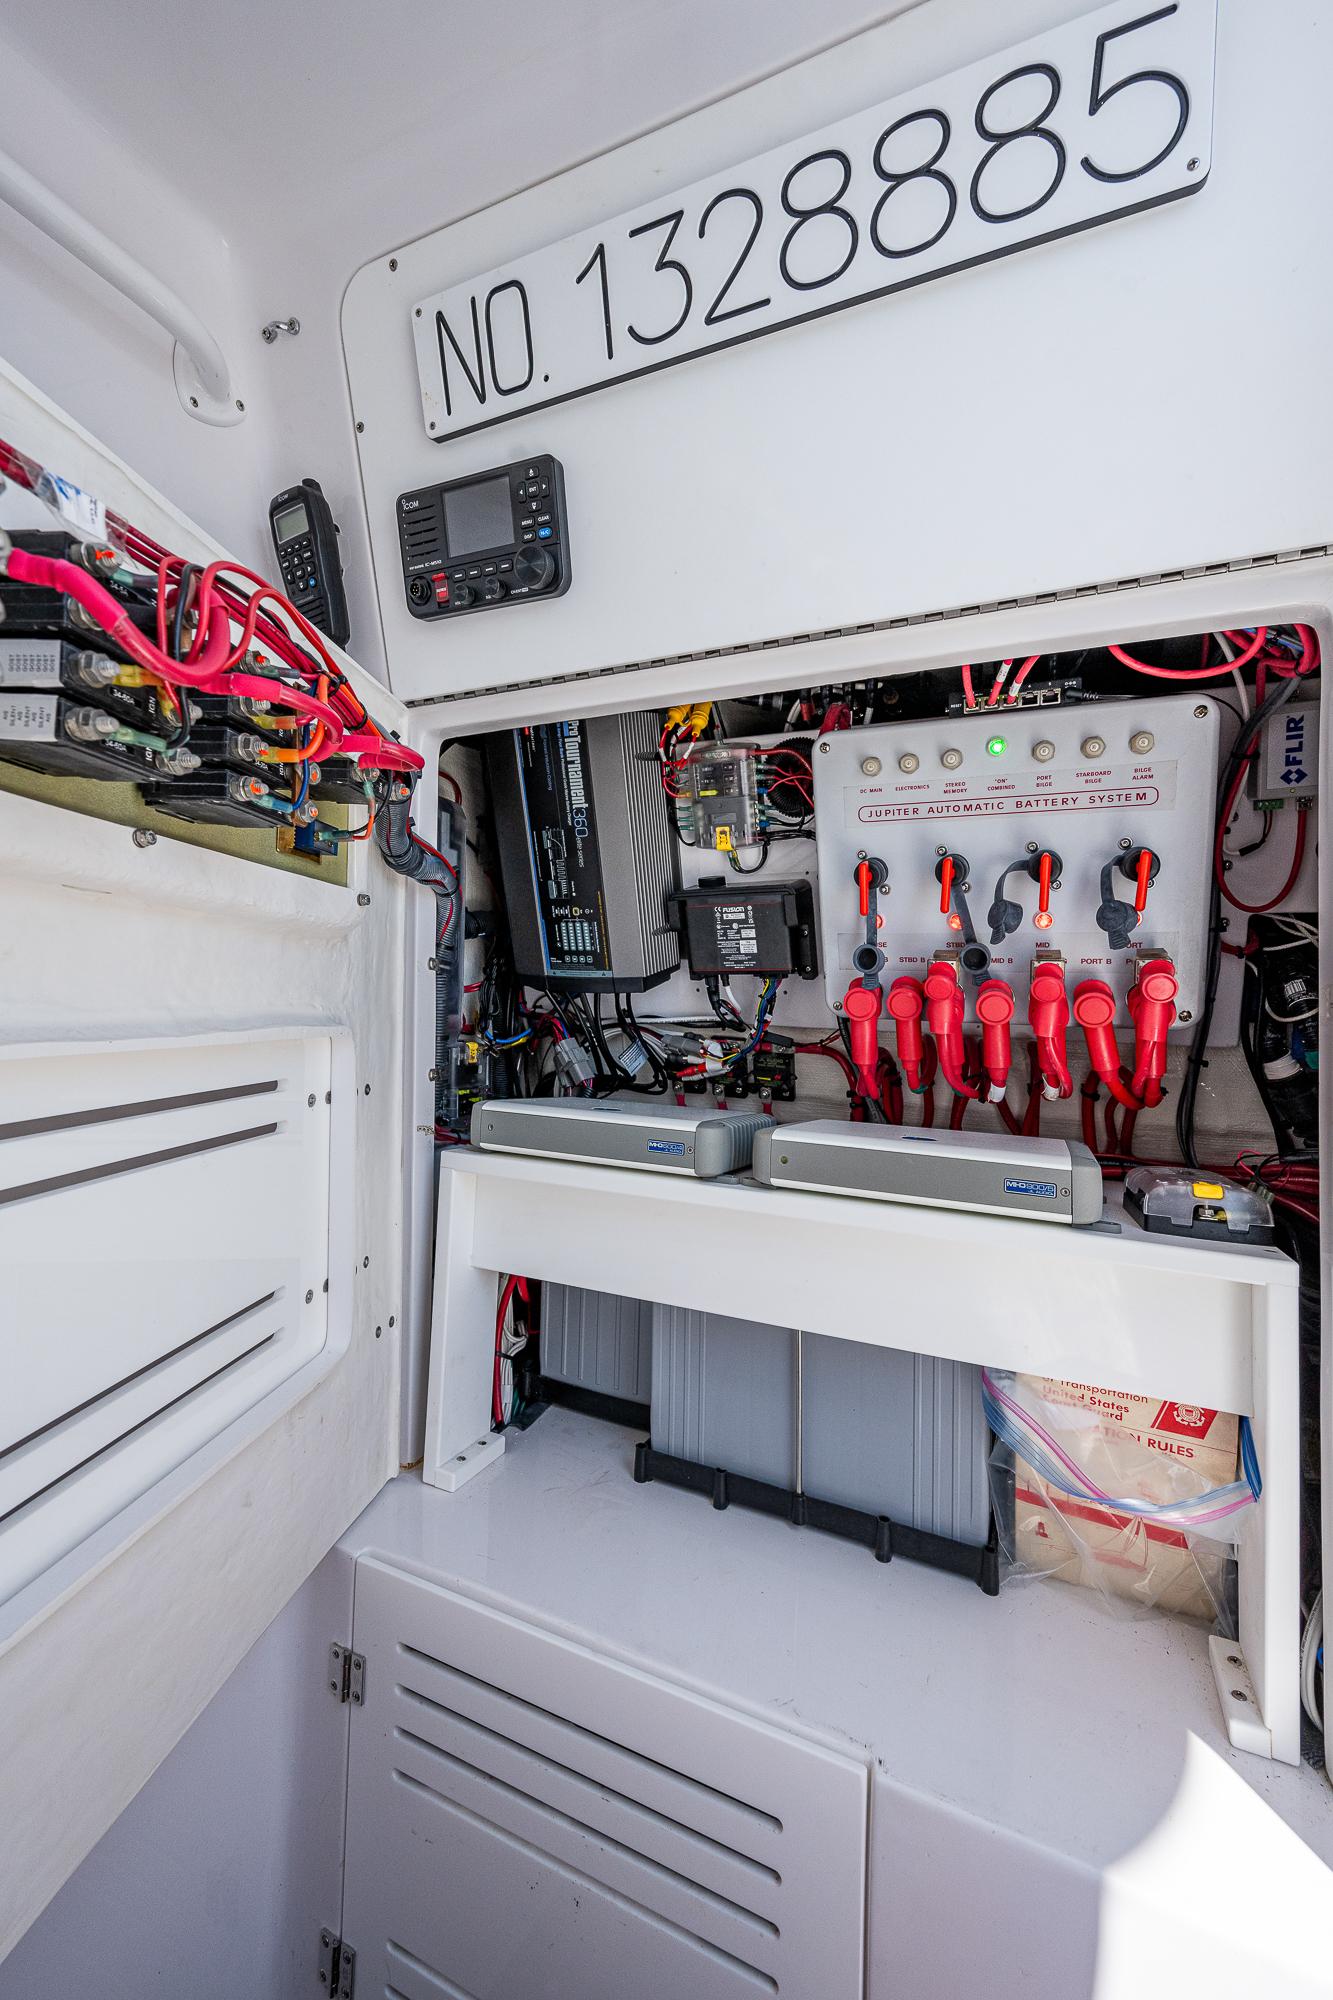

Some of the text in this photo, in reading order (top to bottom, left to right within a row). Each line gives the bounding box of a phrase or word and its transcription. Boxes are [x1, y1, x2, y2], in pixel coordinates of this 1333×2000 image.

[435, 4, 1190, 417] NO. 1328885
[1284, 714, 1305, 767] FLIR
[1075, 770, 1112, 778] STARBOARD
[895, 784, 930, 792] ELECTRONICS
[987, 784, 1016, 792] COMBINED
[868, 792, 1147, 818] JUPITER AUTOMATIC BATTERY SYSTEM
[1042, 1385, 1130, 1414] United States
[1147, 1437, 1194, 1459] RULES
